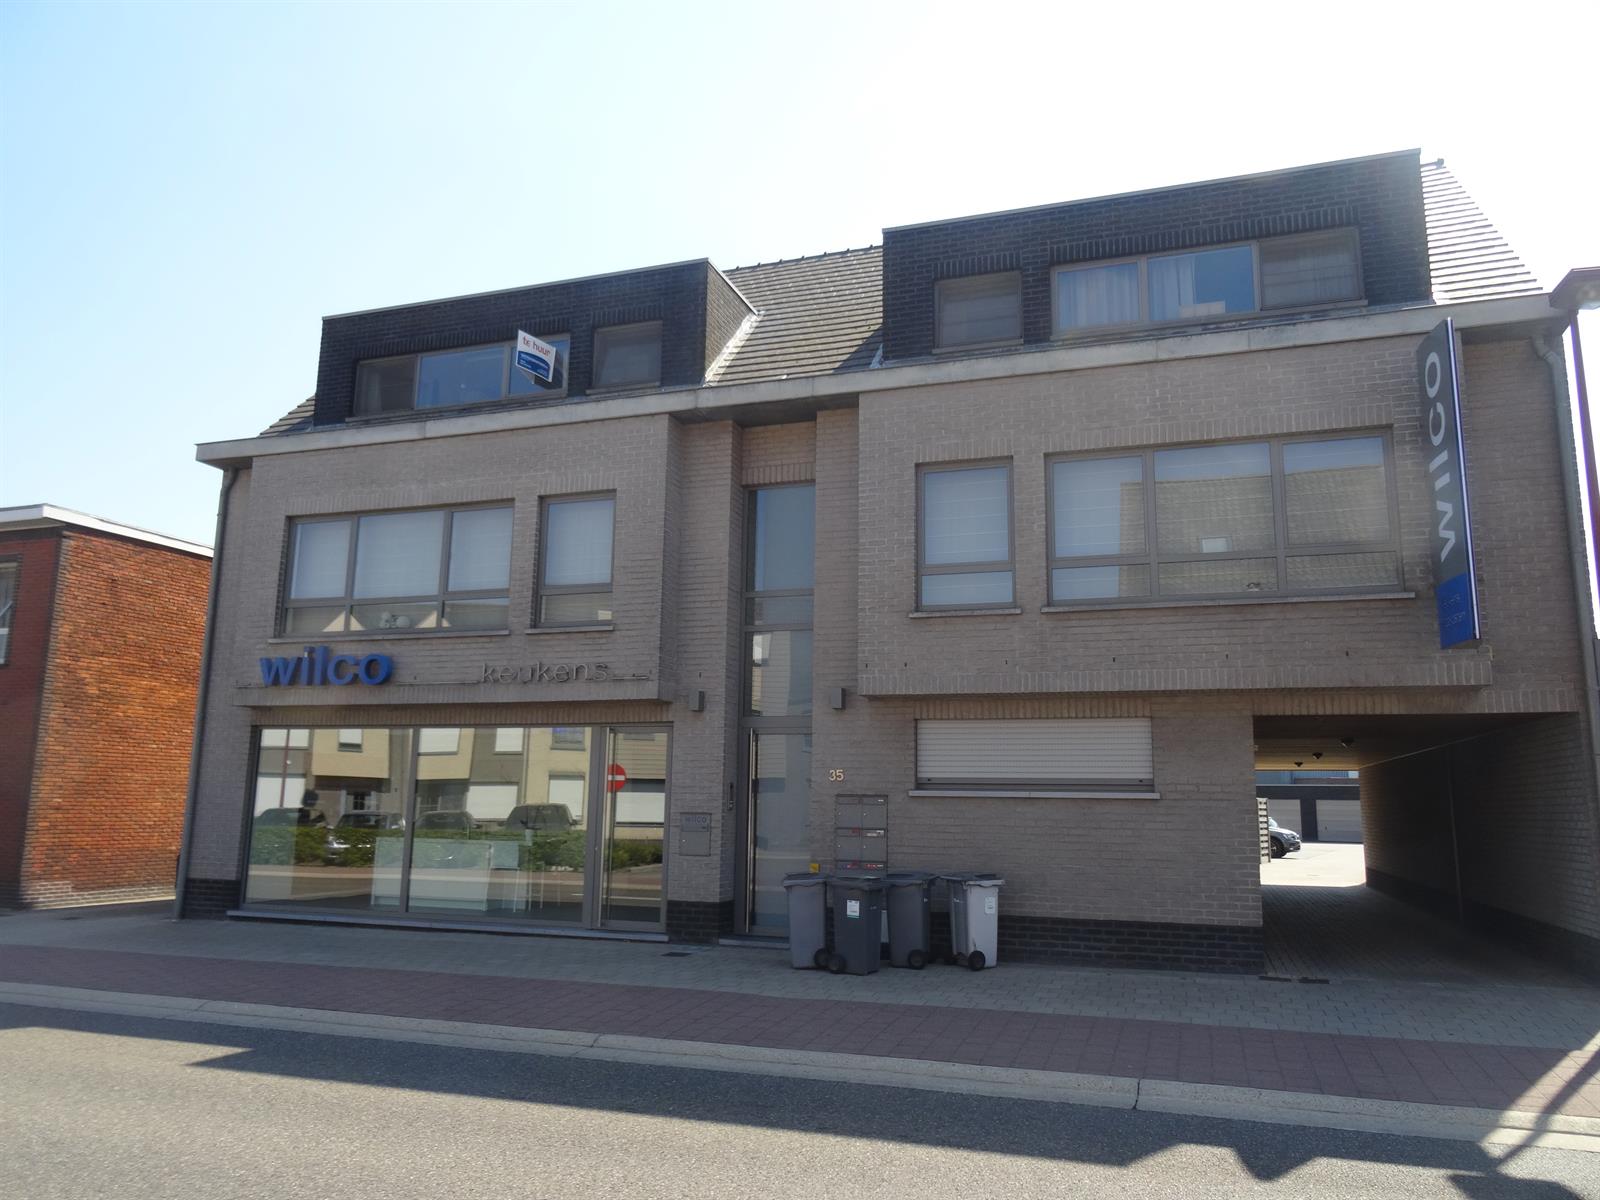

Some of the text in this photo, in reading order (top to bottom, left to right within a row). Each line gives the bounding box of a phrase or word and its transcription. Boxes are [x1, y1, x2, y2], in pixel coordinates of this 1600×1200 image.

[523, 335, 551, 357] te huur
[259, 645, 393, 687] wilco
[482, 661, 608, 683] keukens
[828, 769, 844, 781] 35
